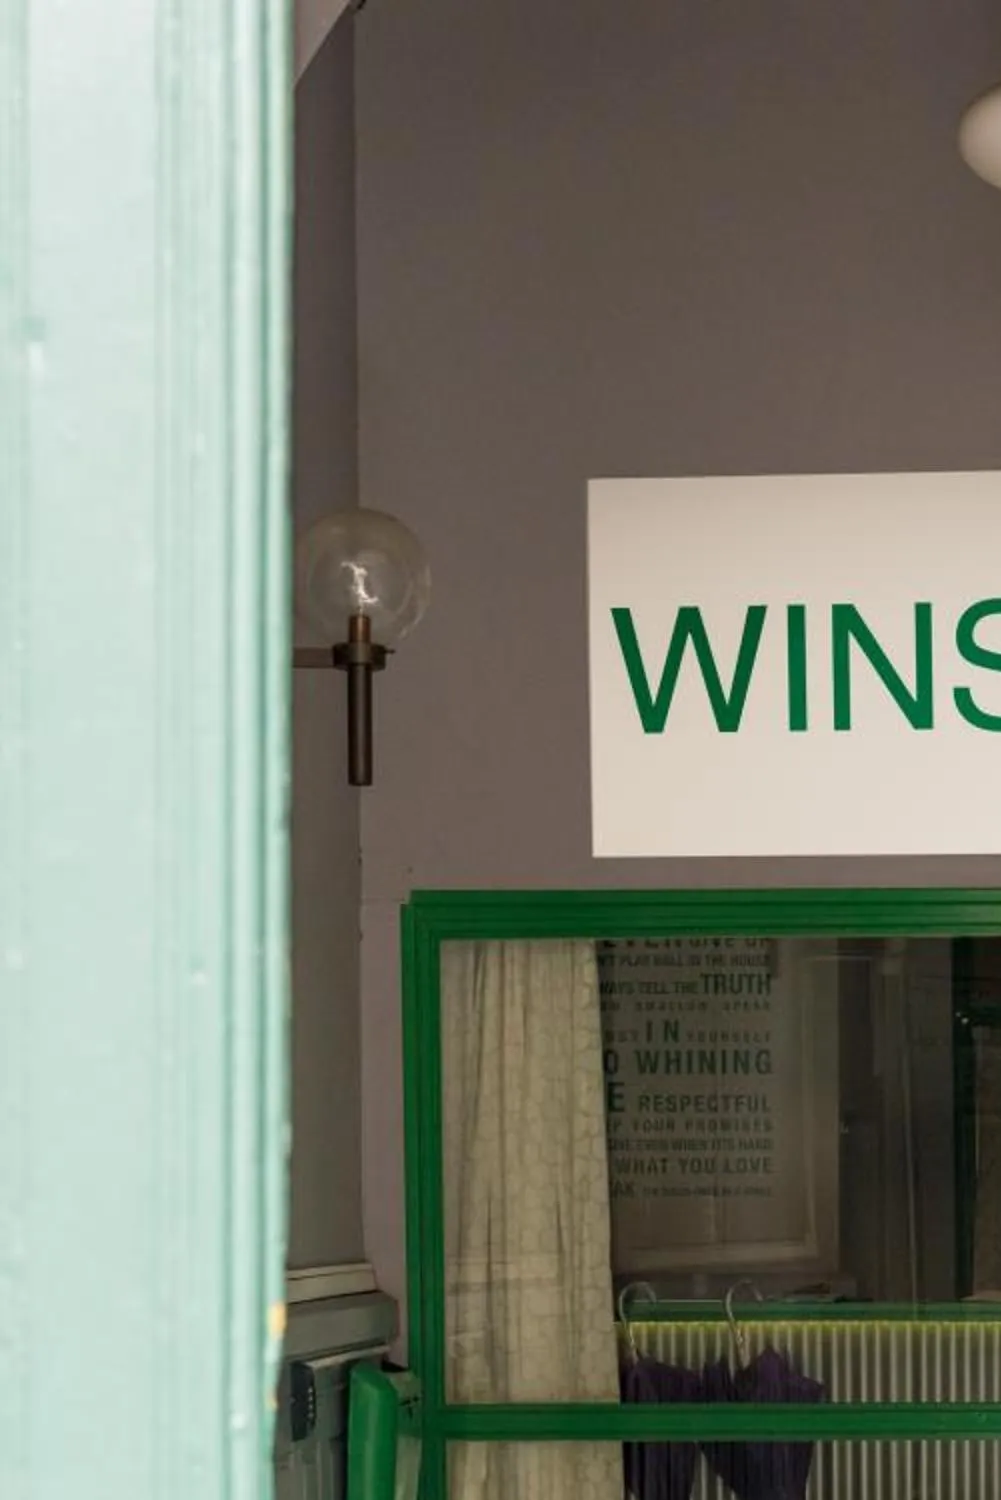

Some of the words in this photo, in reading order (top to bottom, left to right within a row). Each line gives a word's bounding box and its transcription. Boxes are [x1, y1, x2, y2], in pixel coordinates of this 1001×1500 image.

[701, 973, 771, 995] TRUTH
[646, 1020, 680, 1043] IN
[604, 1049, 619, 1074] O
[635, 1049, 772, 1075] WHINING
[607, 1082, 625, 1113] E
[637, 1095, 771, 1113] RESPECTFUL
[615, 1158, 668, 1174] WHAT
[677, 1158, 714, 1174] YOU
[723, 1158, 775, 1173] LOVE
